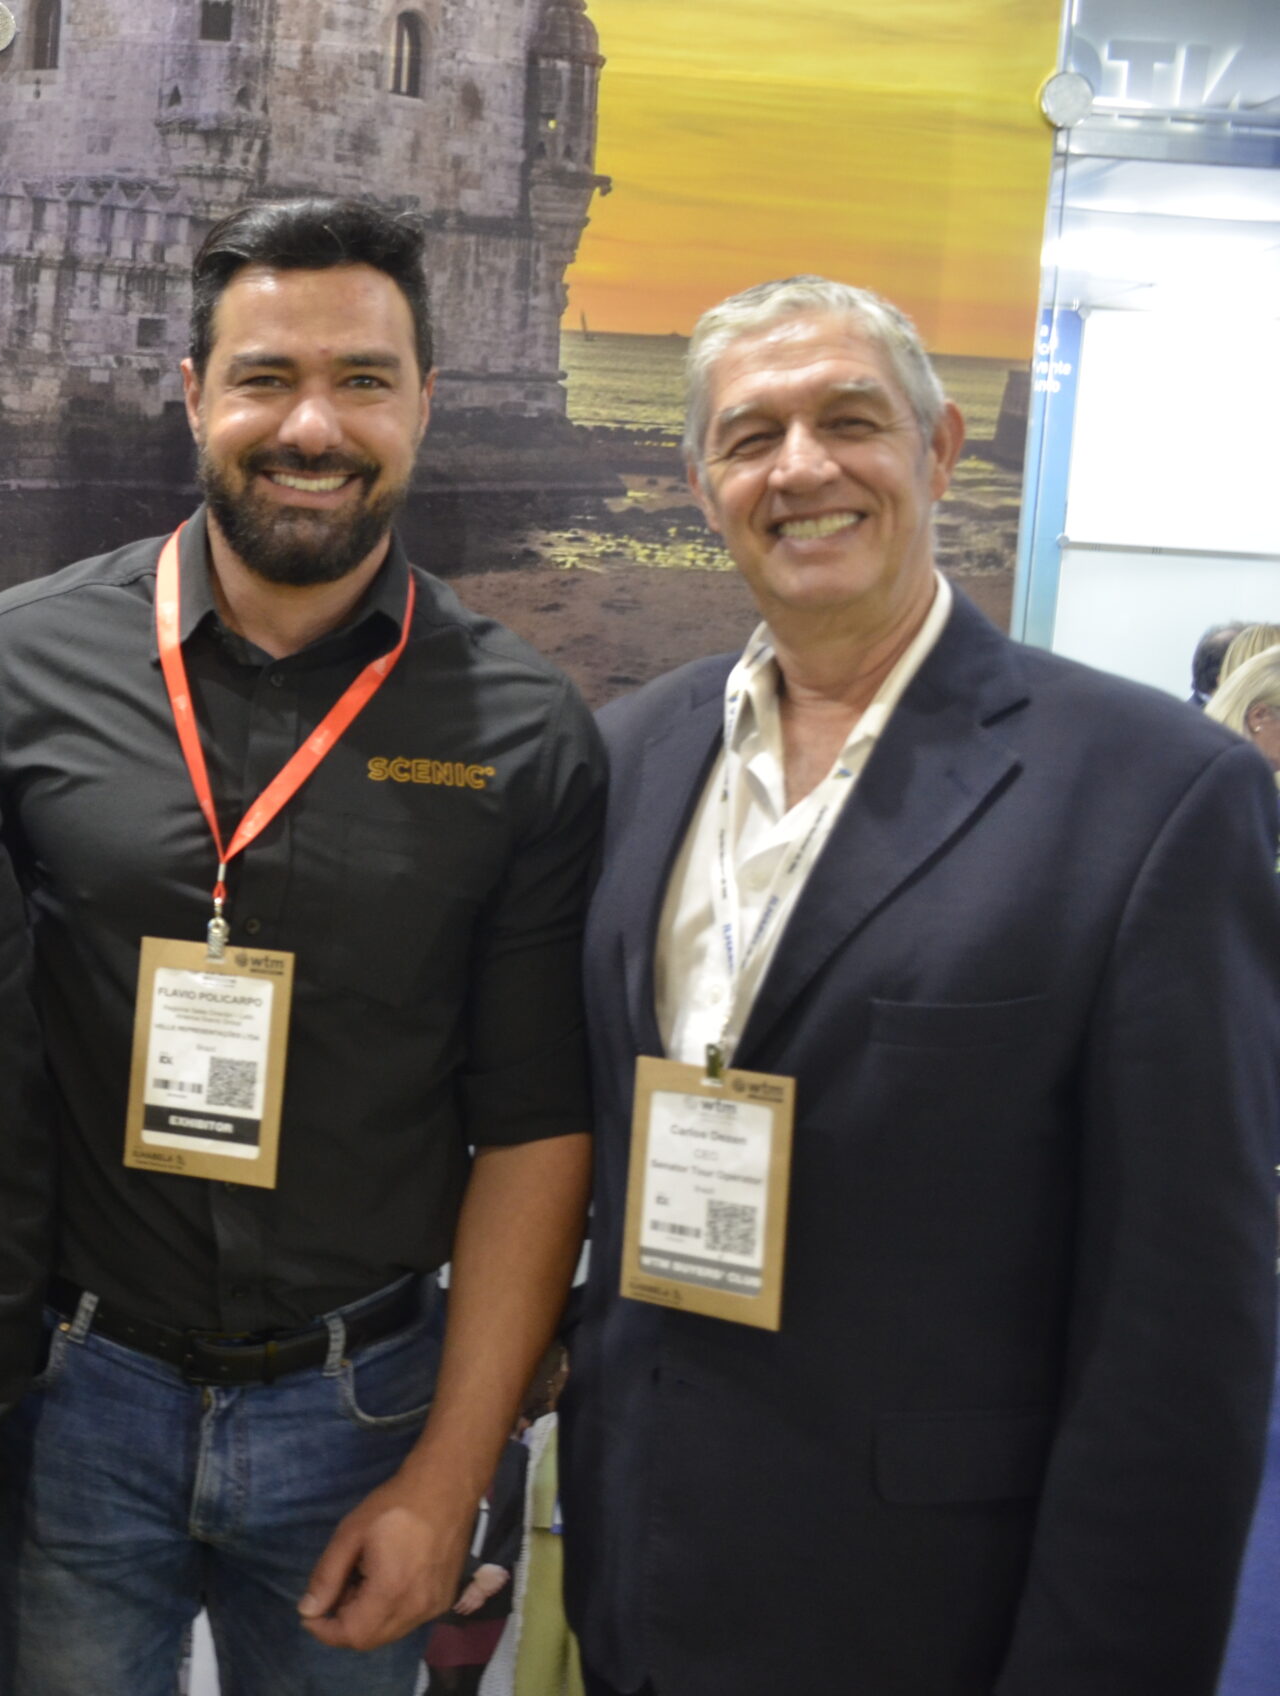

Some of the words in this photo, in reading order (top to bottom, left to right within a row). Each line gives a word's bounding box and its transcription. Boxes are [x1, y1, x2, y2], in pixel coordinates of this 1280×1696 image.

[368, 757, 486, 789] SCENIC
[250, 955, 284, 969] wtm
[158, 986, 197, 1000] FLAVIO
[198, 992, 263, 1007] POLICARPO
[702, 1101, 737, 1113] wtm
[168, 1115, 234, 1134] EXHIBITOR
